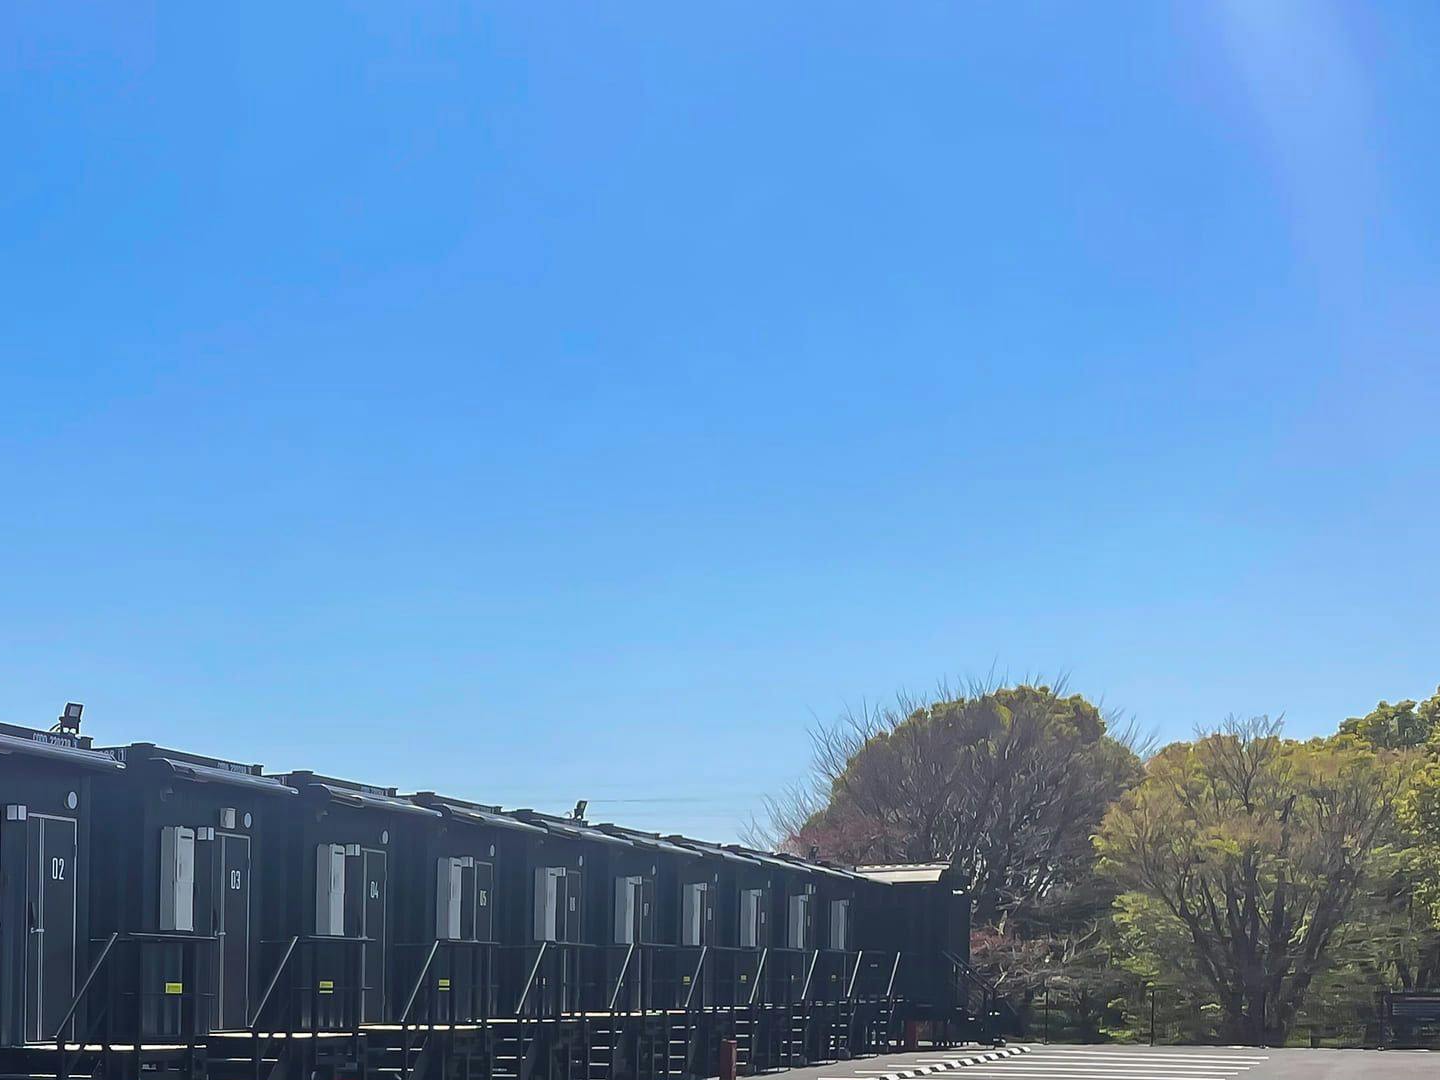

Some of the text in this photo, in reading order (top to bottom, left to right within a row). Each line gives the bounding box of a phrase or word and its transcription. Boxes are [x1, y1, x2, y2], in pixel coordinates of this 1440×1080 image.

[52, 857, 65, 880] 02
[230, 870, 241, 890] 03
[370, 881, 379, 899] 04
